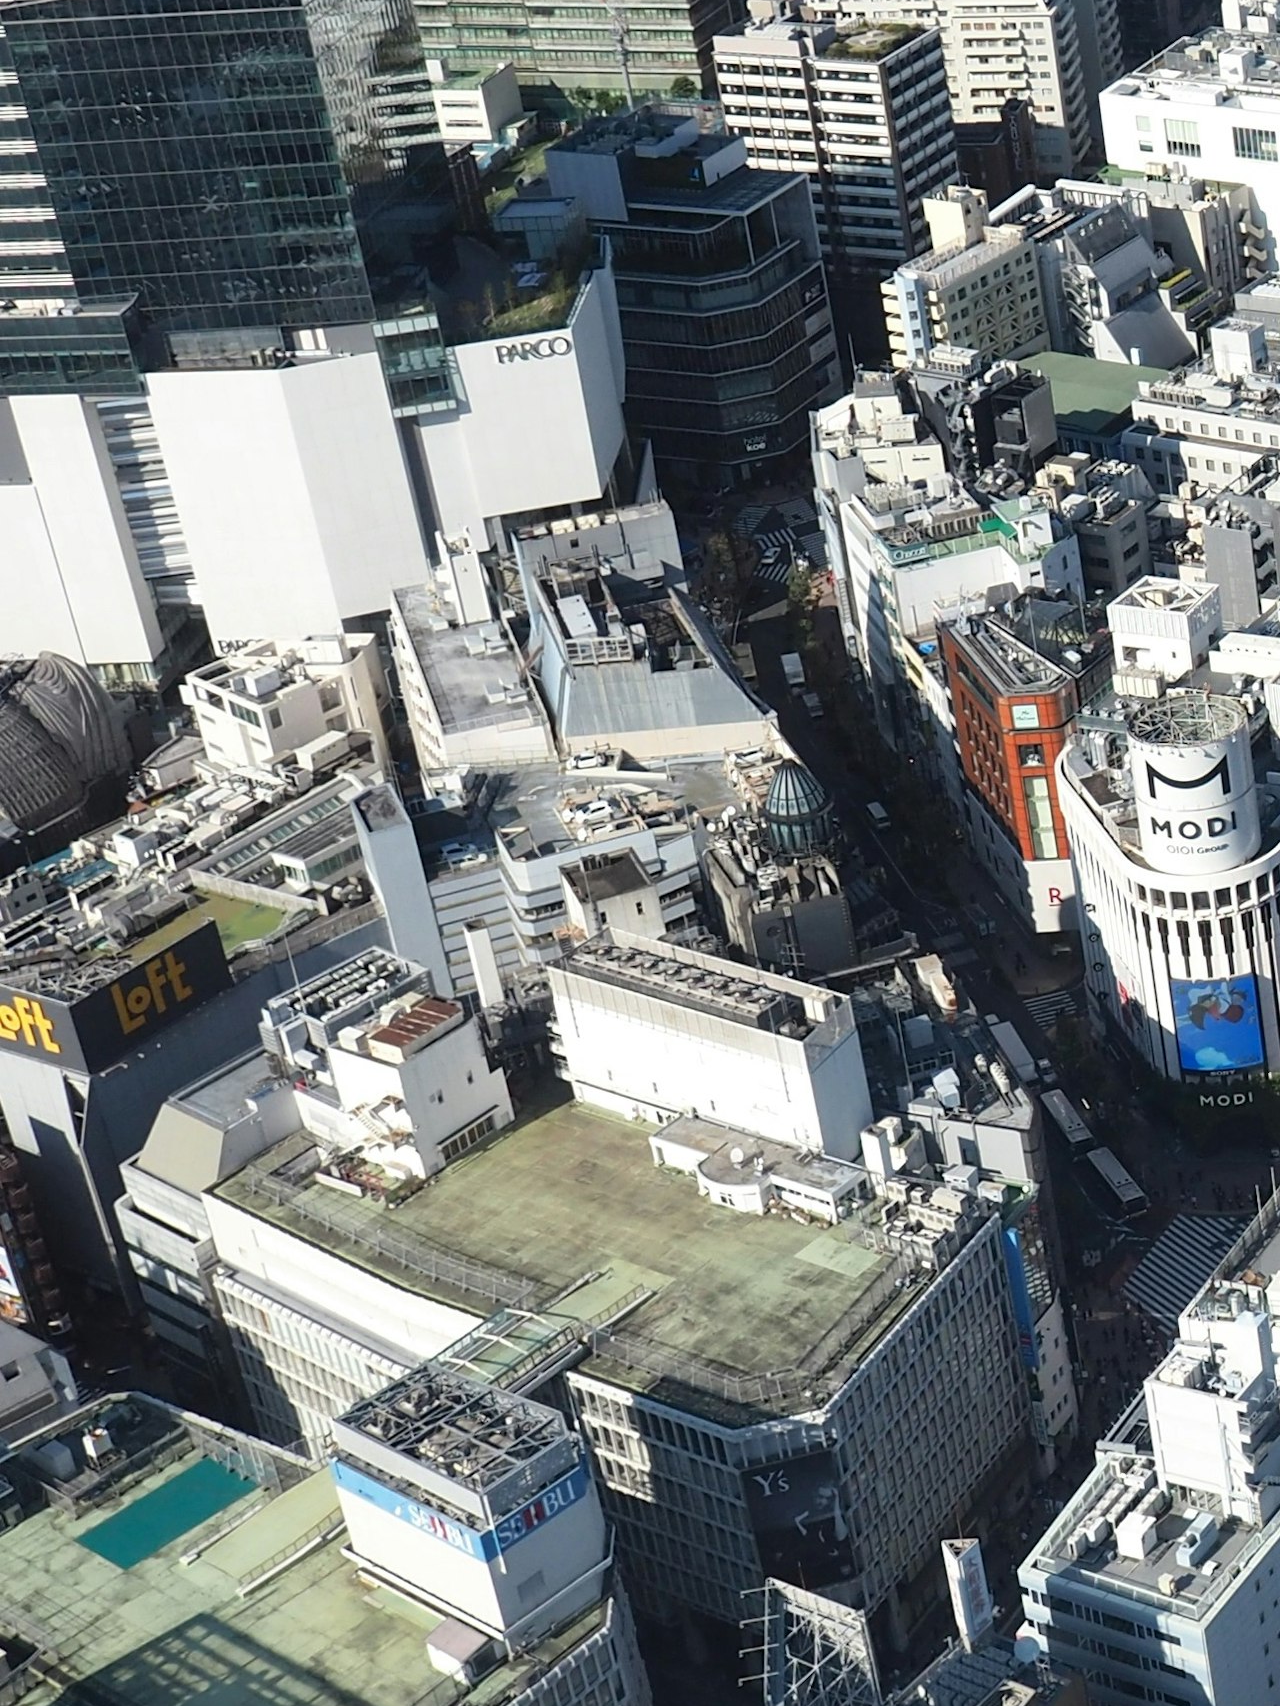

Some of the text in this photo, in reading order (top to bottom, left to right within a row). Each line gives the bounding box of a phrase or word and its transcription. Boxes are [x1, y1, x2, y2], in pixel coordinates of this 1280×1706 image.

[496, 336, 573, 364] PARCO
[1150, 810, 1238, 840] MODI
[1196, 842, 1231, 855] GROUP
[1048, 887, 1063, 904] R
[1199, 1091, 1254, 1108] MODI
[752, 1468, 790, 1497] Y's
[497, 1479, 577, 1549] SEIBU
